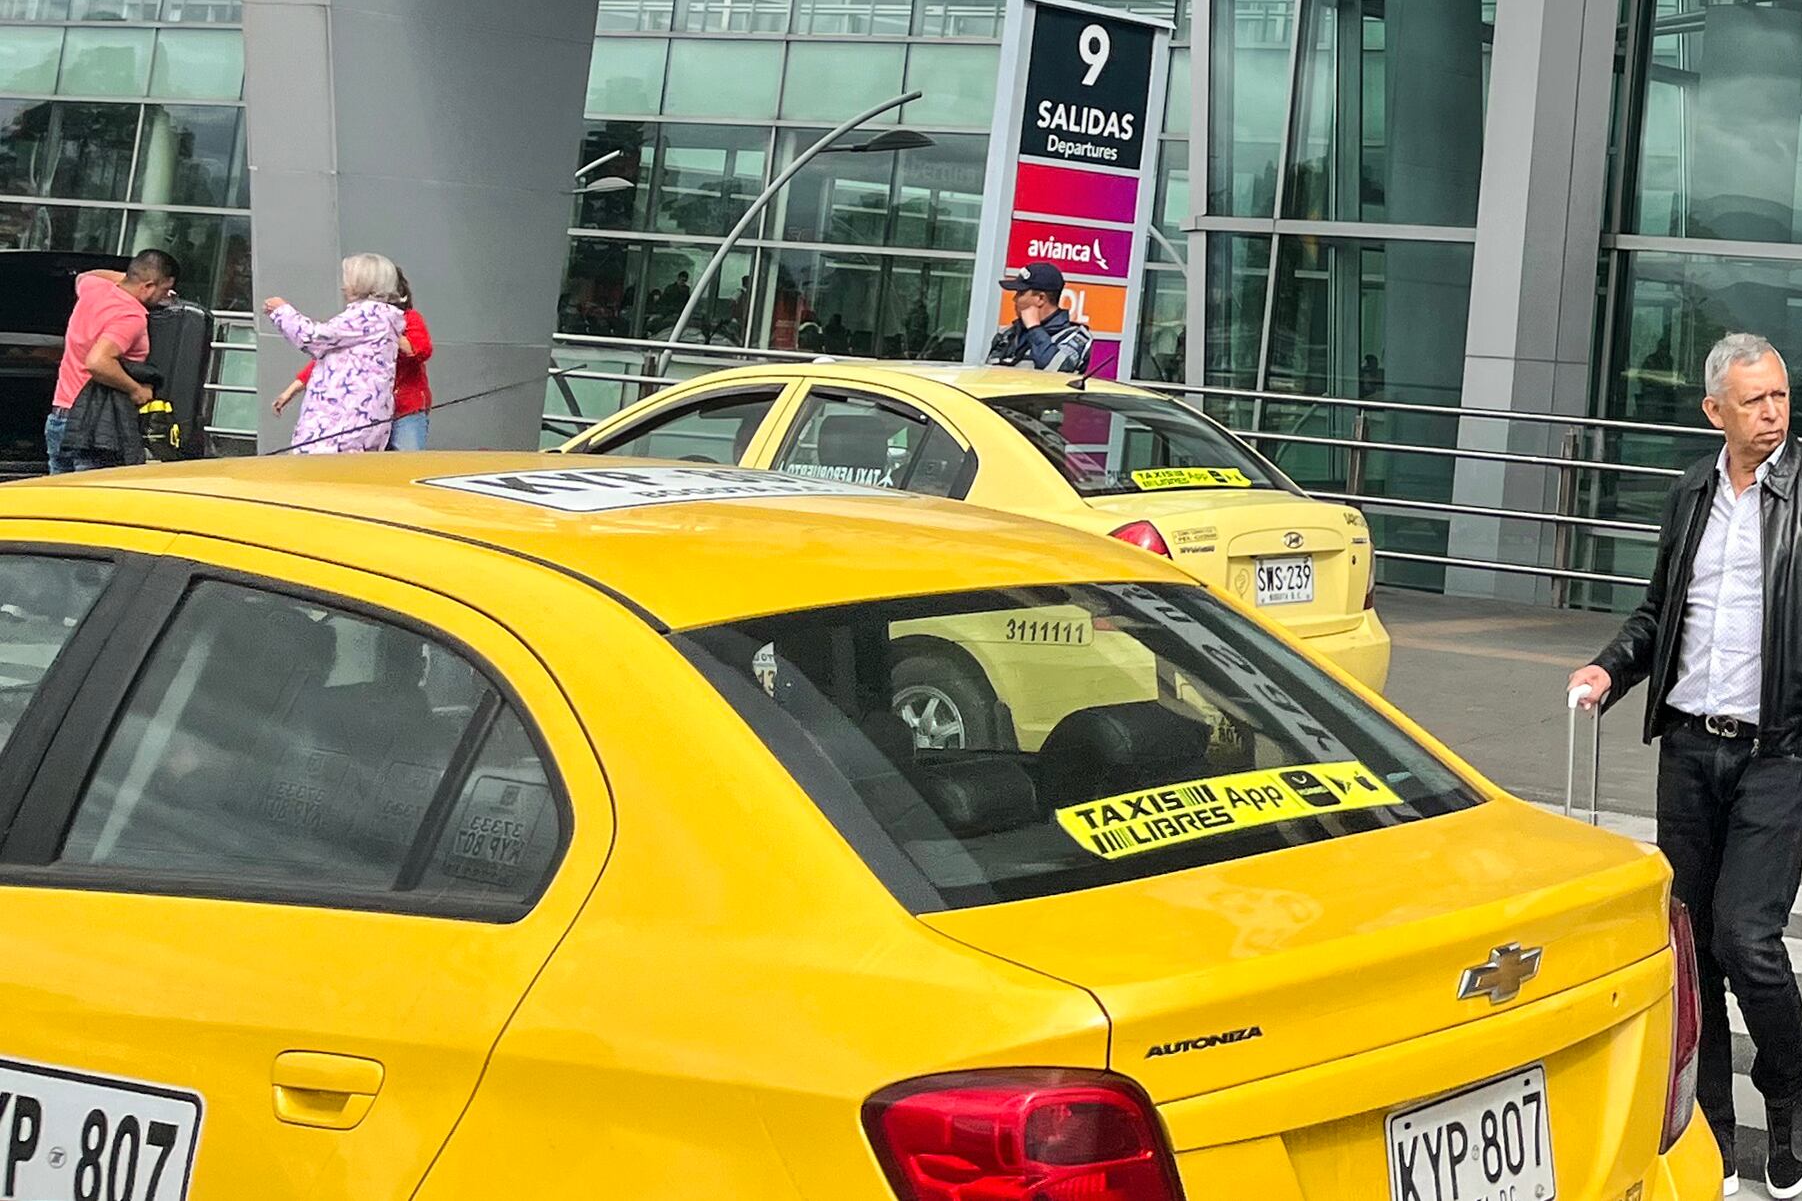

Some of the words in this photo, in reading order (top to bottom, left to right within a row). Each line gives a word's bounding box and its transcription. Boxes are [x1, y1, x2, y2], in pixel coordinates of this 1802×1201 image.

[1078, 23, 1111, 86] 9
[1036, 100, 1135, 141] SALIDAS
[1046, 134, 1118, 161] Departures
[1027, 235, 1091, 263] avianca
[1058, 288, 1090, 323] OL
[1287, 564, 1311, 590] 239
[1006, 618, 1084, 644] 3111111
[1074, 790, 1186, 830] TAXIS
[1223, 784, 1285, 812] App
[1125, 805, 1236, 845] LIBRES
[1144, 1026, 1263, 1059] AUTONIZA
[74, 1108, 179, 1201] 807
[1398, 1121, 1468, 1201] KYP
[1481, 1091, 1541, 1184] 807
